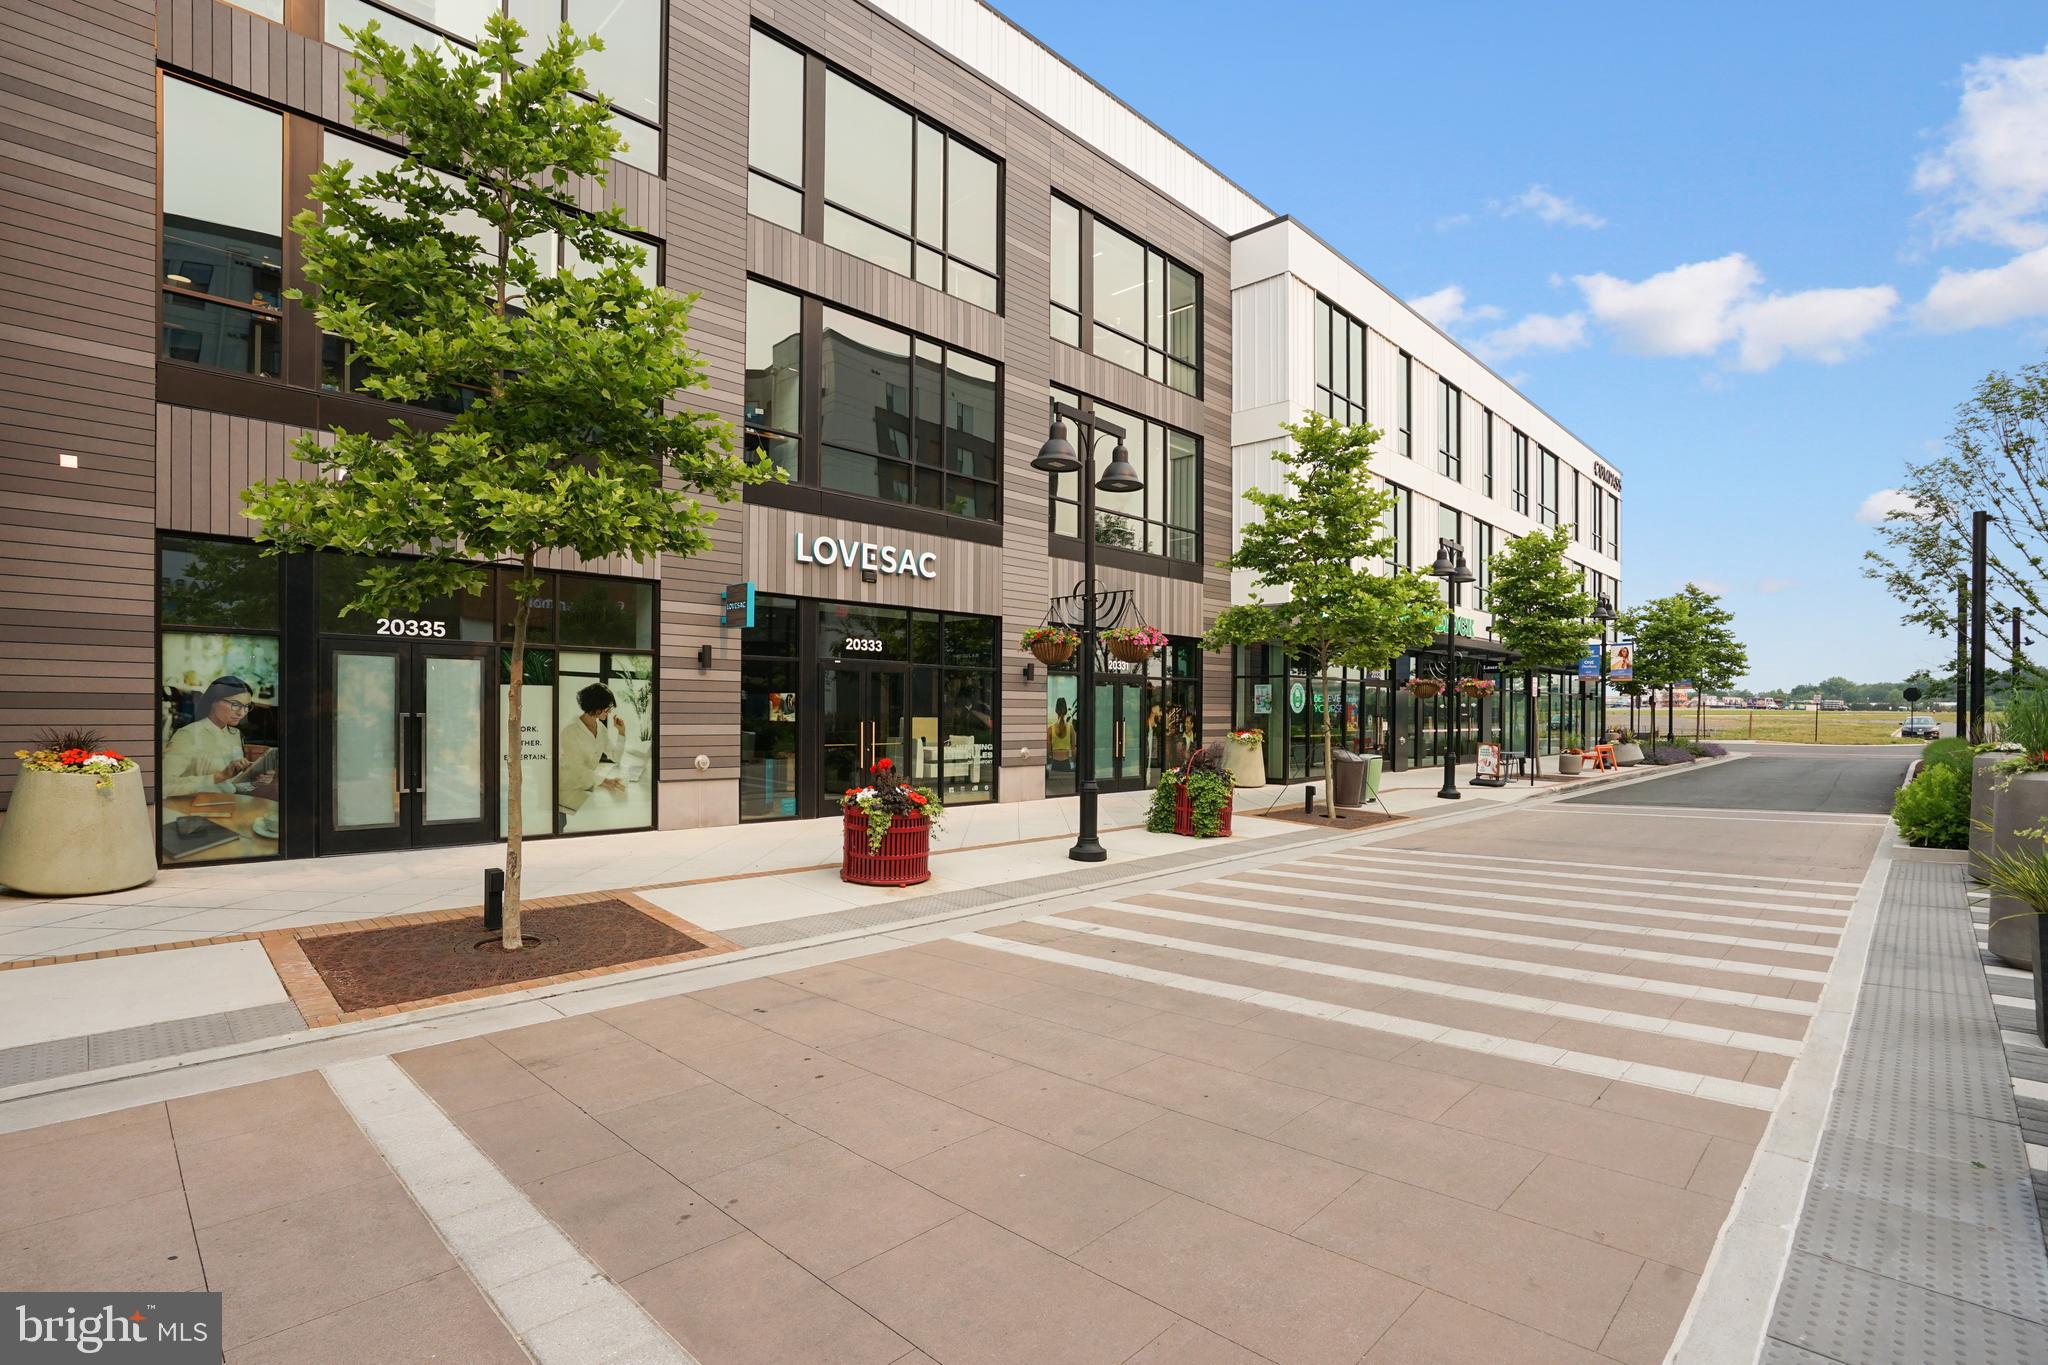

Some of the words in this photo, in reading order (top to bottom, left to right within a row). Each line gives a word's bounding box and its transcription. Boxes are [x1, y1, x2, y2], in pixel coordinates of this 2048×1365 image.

[796, 531, 937, 579] LOVESAC
[376, 618, 446, 637] 20335
[845, 637, 883, 652] 20333
[1108, 660, 1129, 671] 20331
